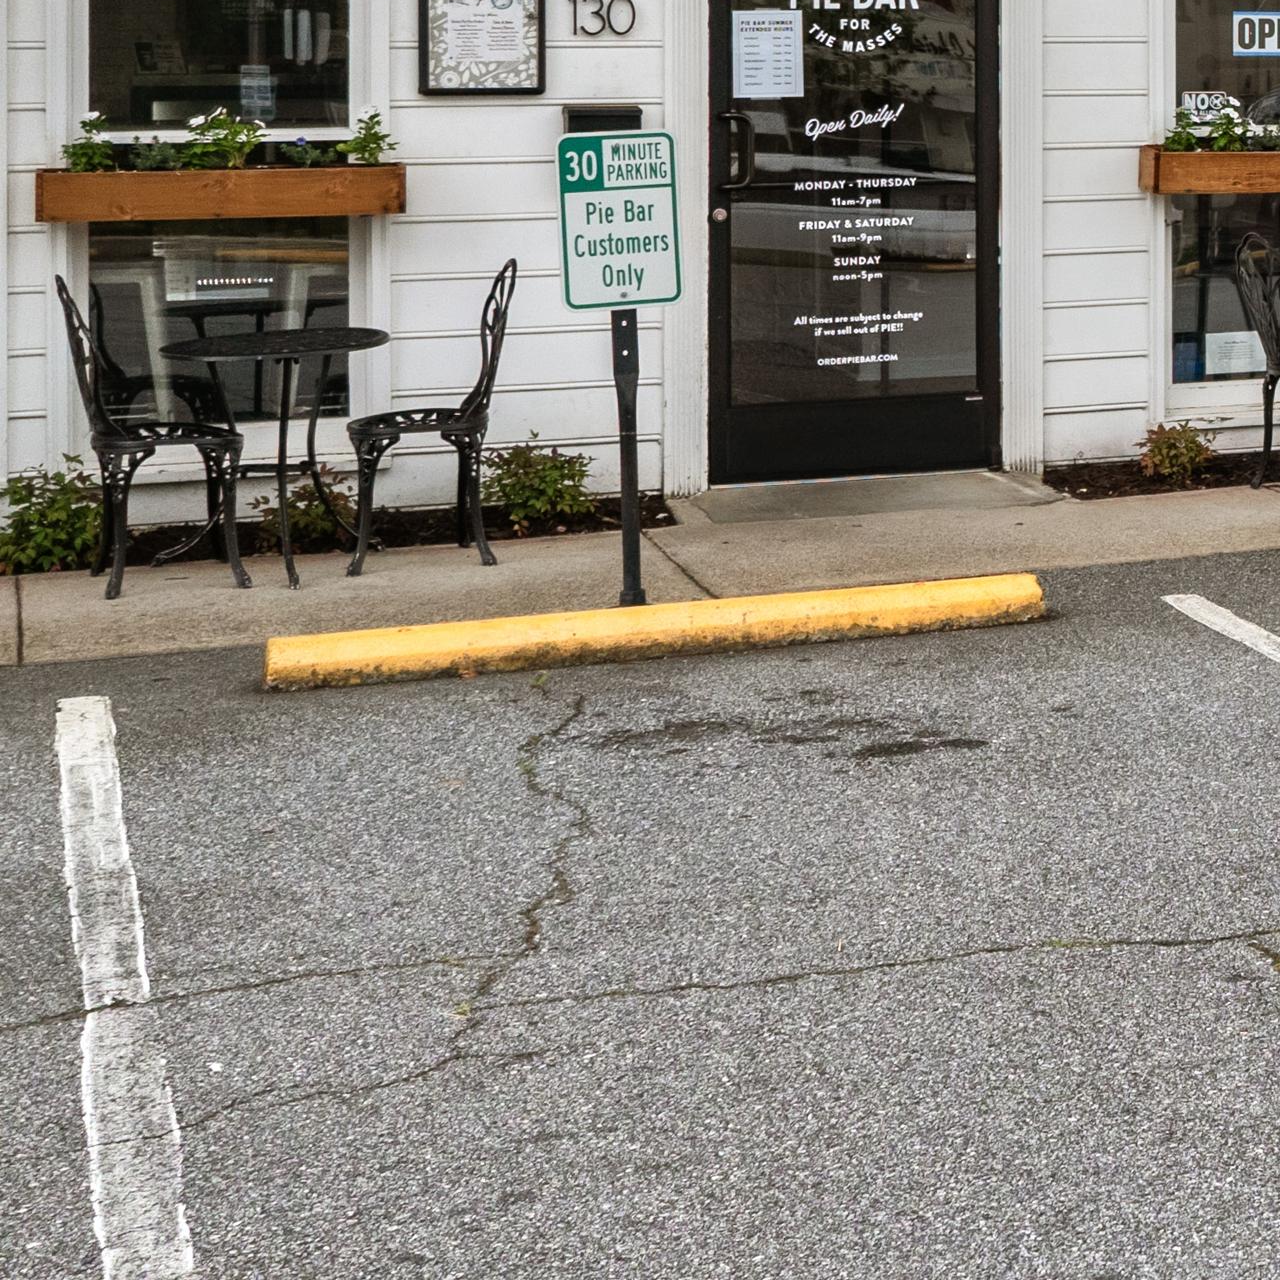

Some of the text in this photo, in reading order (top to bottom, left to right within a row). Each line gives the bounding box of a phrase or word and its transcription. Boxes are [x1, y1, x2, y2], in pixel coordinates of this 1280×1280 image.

[840, 18, 870, 30] FOR
[808, 23, 837, 48] THE
[842, 23, 902, 52] MASSES
[1184, 93, 1209, 110] NO
[805, 103, 905, 142] Open Daily!
[565, 142, 663, 182] 30 MINUTE
[607, 161, 667, 182] PARKING
[794, 180, 846, 191] MONDAY
[856, 177, 917, 189] THURSDAY
[831, 196, 881, 208] 11am-7pm
[585, 199, 654, 225] Pie Bar
[799, 217, 914, 231] FRIDAY & SATURDAY
[574, 233, 669, 258] Customers
[831, 233, 882, 245] 11am-9pm
[834, 256, 881, 266] SUNDAY
[602, 263, 645, 291] Only
[832, 271, 883, 282] noon-5pm
[794, 316, 807, 325] All
[809, 315, 833, 325] times
[850, 313, 880, 324] subject
[893, 311, 923, 321] change
[837, 326, 851, 335] sell
[853, 326, 868, 334] out
[870, 324, 879, 333] of
[881, 323, 904, 332] PIE!!
[817, 354, 898, 366] ORDERPIEBAR.COM
